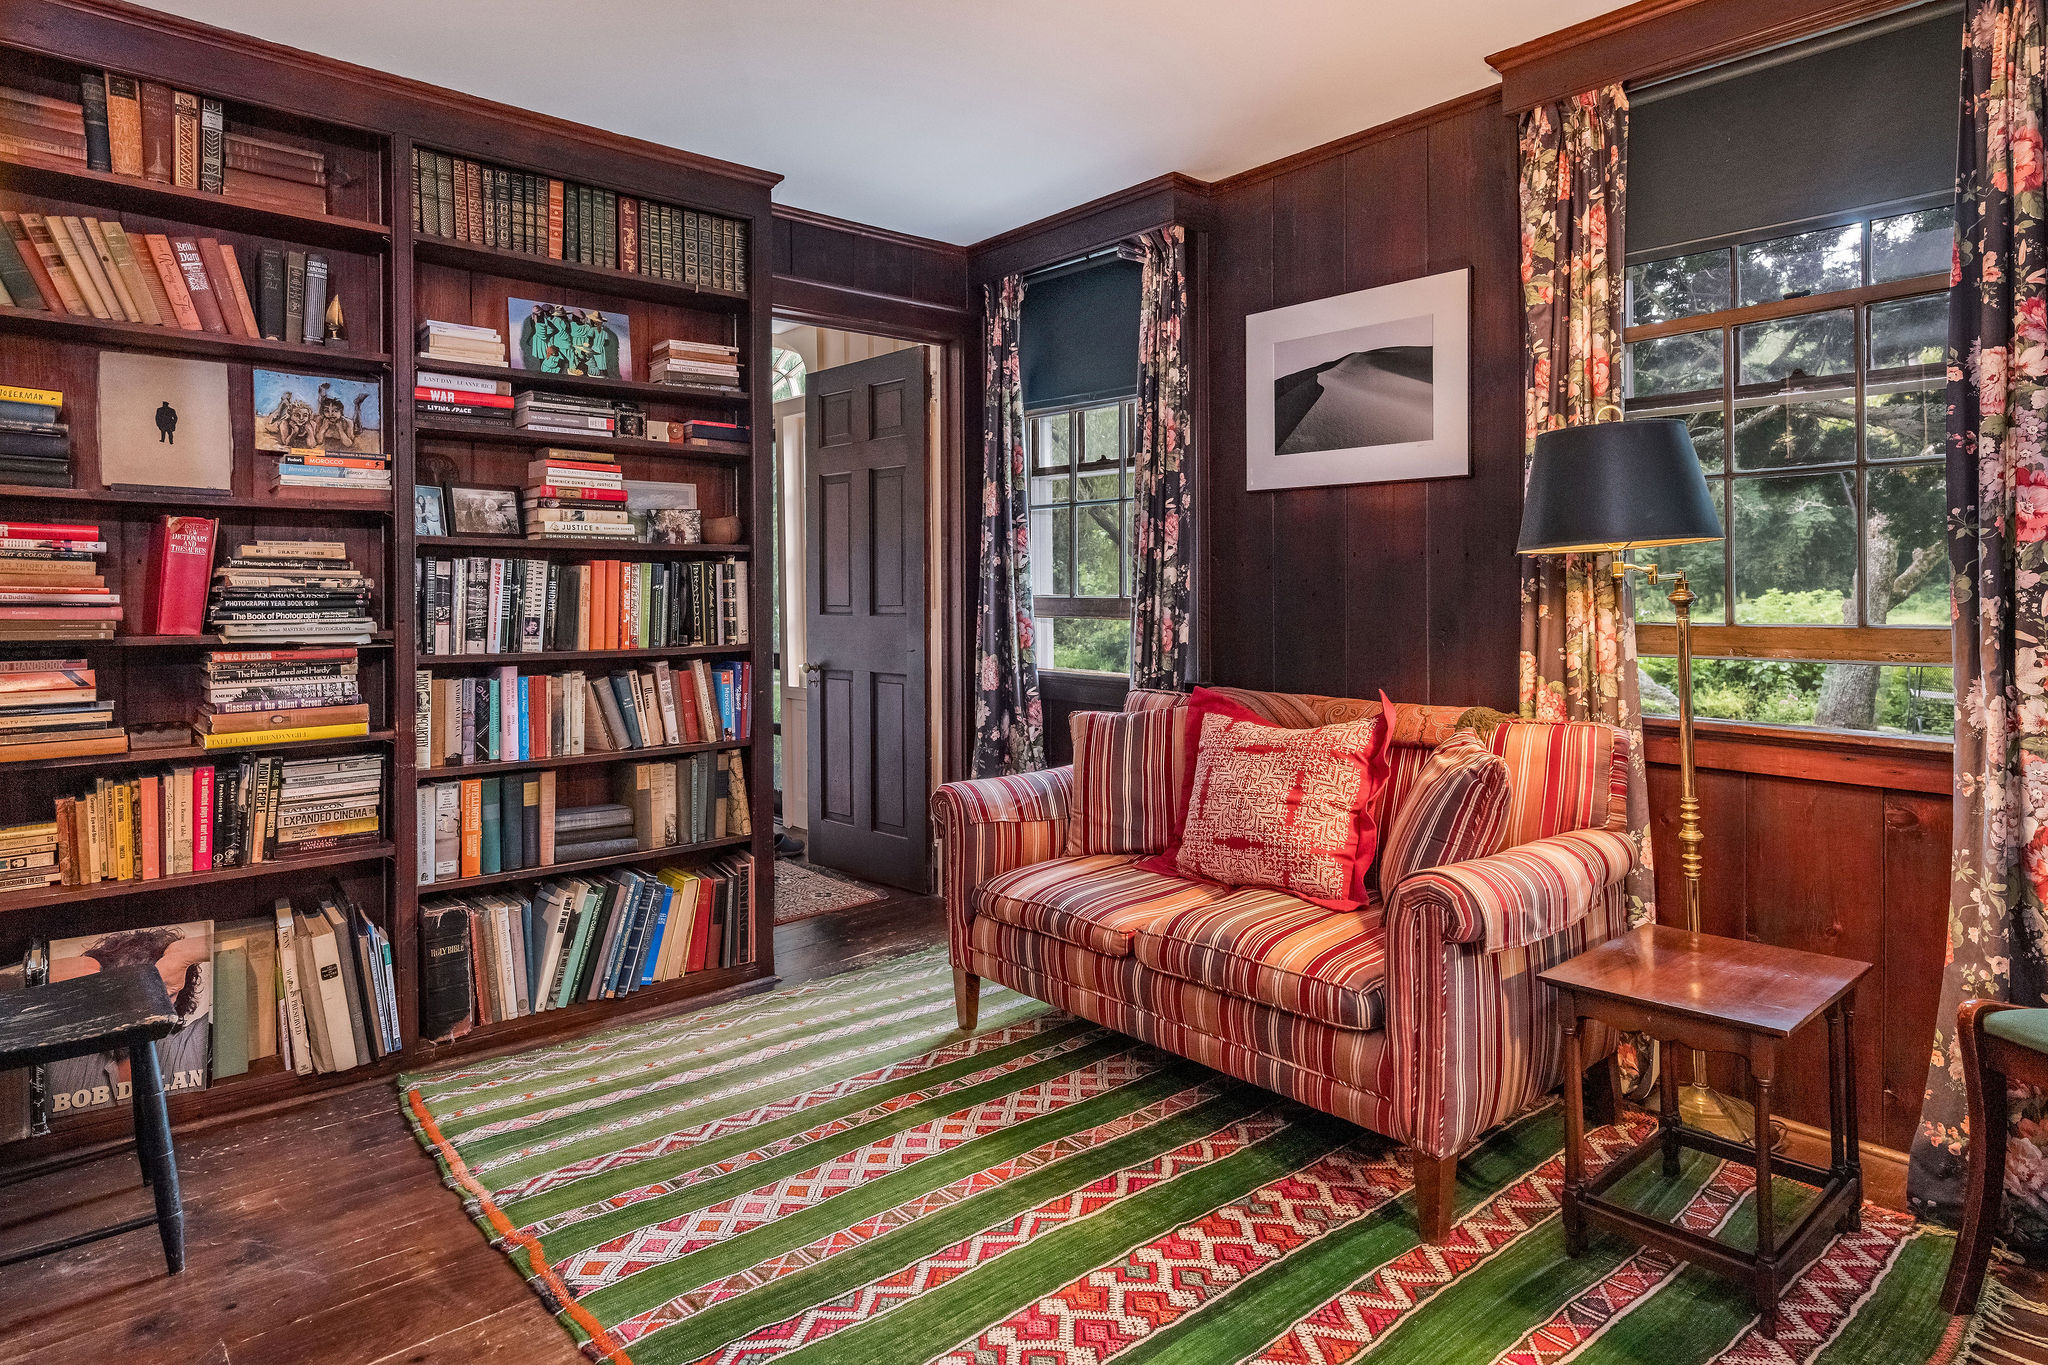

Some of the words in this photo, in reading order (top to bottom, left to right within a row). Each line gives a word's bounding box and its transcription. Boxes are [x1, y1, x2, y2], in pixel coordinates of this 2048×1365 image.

[179, 253, 200, 262] Diary
[430, 390, 455, 403] WAR
[172, 533, 208, 542] DICTIONARY
[183, 540, 197, 548] AND
[171, 544, 206, 555] THESAURUS
[494, 563, 502, 573] BOB
[536, 561, 544, 579] JIMI
[526, 561, 534, 593] ELECTRIC
[534, 583, 542, 617] HENDRIX
[548, 581, 557, 611] HENDRIX
[692, 566, 700, 626] BRANDO
[232, 612, 246, 620] The
[247, 612, 265, 620] Book
[267, 612, 275, 620] of
[276, 611, 321, 621] Photography
[224, 653, 240, 661] W.C.
[241, 652, 272, 660] FIELDS
[15, 661, 64, 670] HANDBOOK
[250, 669, 266, 677] Films
[266, 668, 275, 676] of
[275, 668, 295, 676] Laurel
[309, 665, 332, 675] Hardy
[417, 673, 429, 691] MARY
[225, 703, 253, 712] Classics
[264, 701, 276, 710] the
[278, 700, 298, 709] Silent
[300, 699, 322, 708] Screen
[259, 763, 269, 785] MOVIE
[272, 769, 280, 786] BARE
[256, 788, 267, 814] PEOPLE
[283, 802, 345, 813] SATYRICON
[471, 785, 479, 829] WELLINGTON
[200, 806, 208, 818] plays
[283, 812, 331, 826] EXPANDED
[333, 808, 367, 820] CINEMA
[624, 892, 632, 906] LOVE
[740, 866, 749, 931] PAINTING
[430, 947, 448, 958] HOLY
[447, 944, 464, 954] BIBLE
[282, 931, 290, 949] PENN
[291, 999, 302, 1035] PRESERVED
[52, 1085, 110, 1113] BOB
[116, 1068, 203, 1101] DAN
